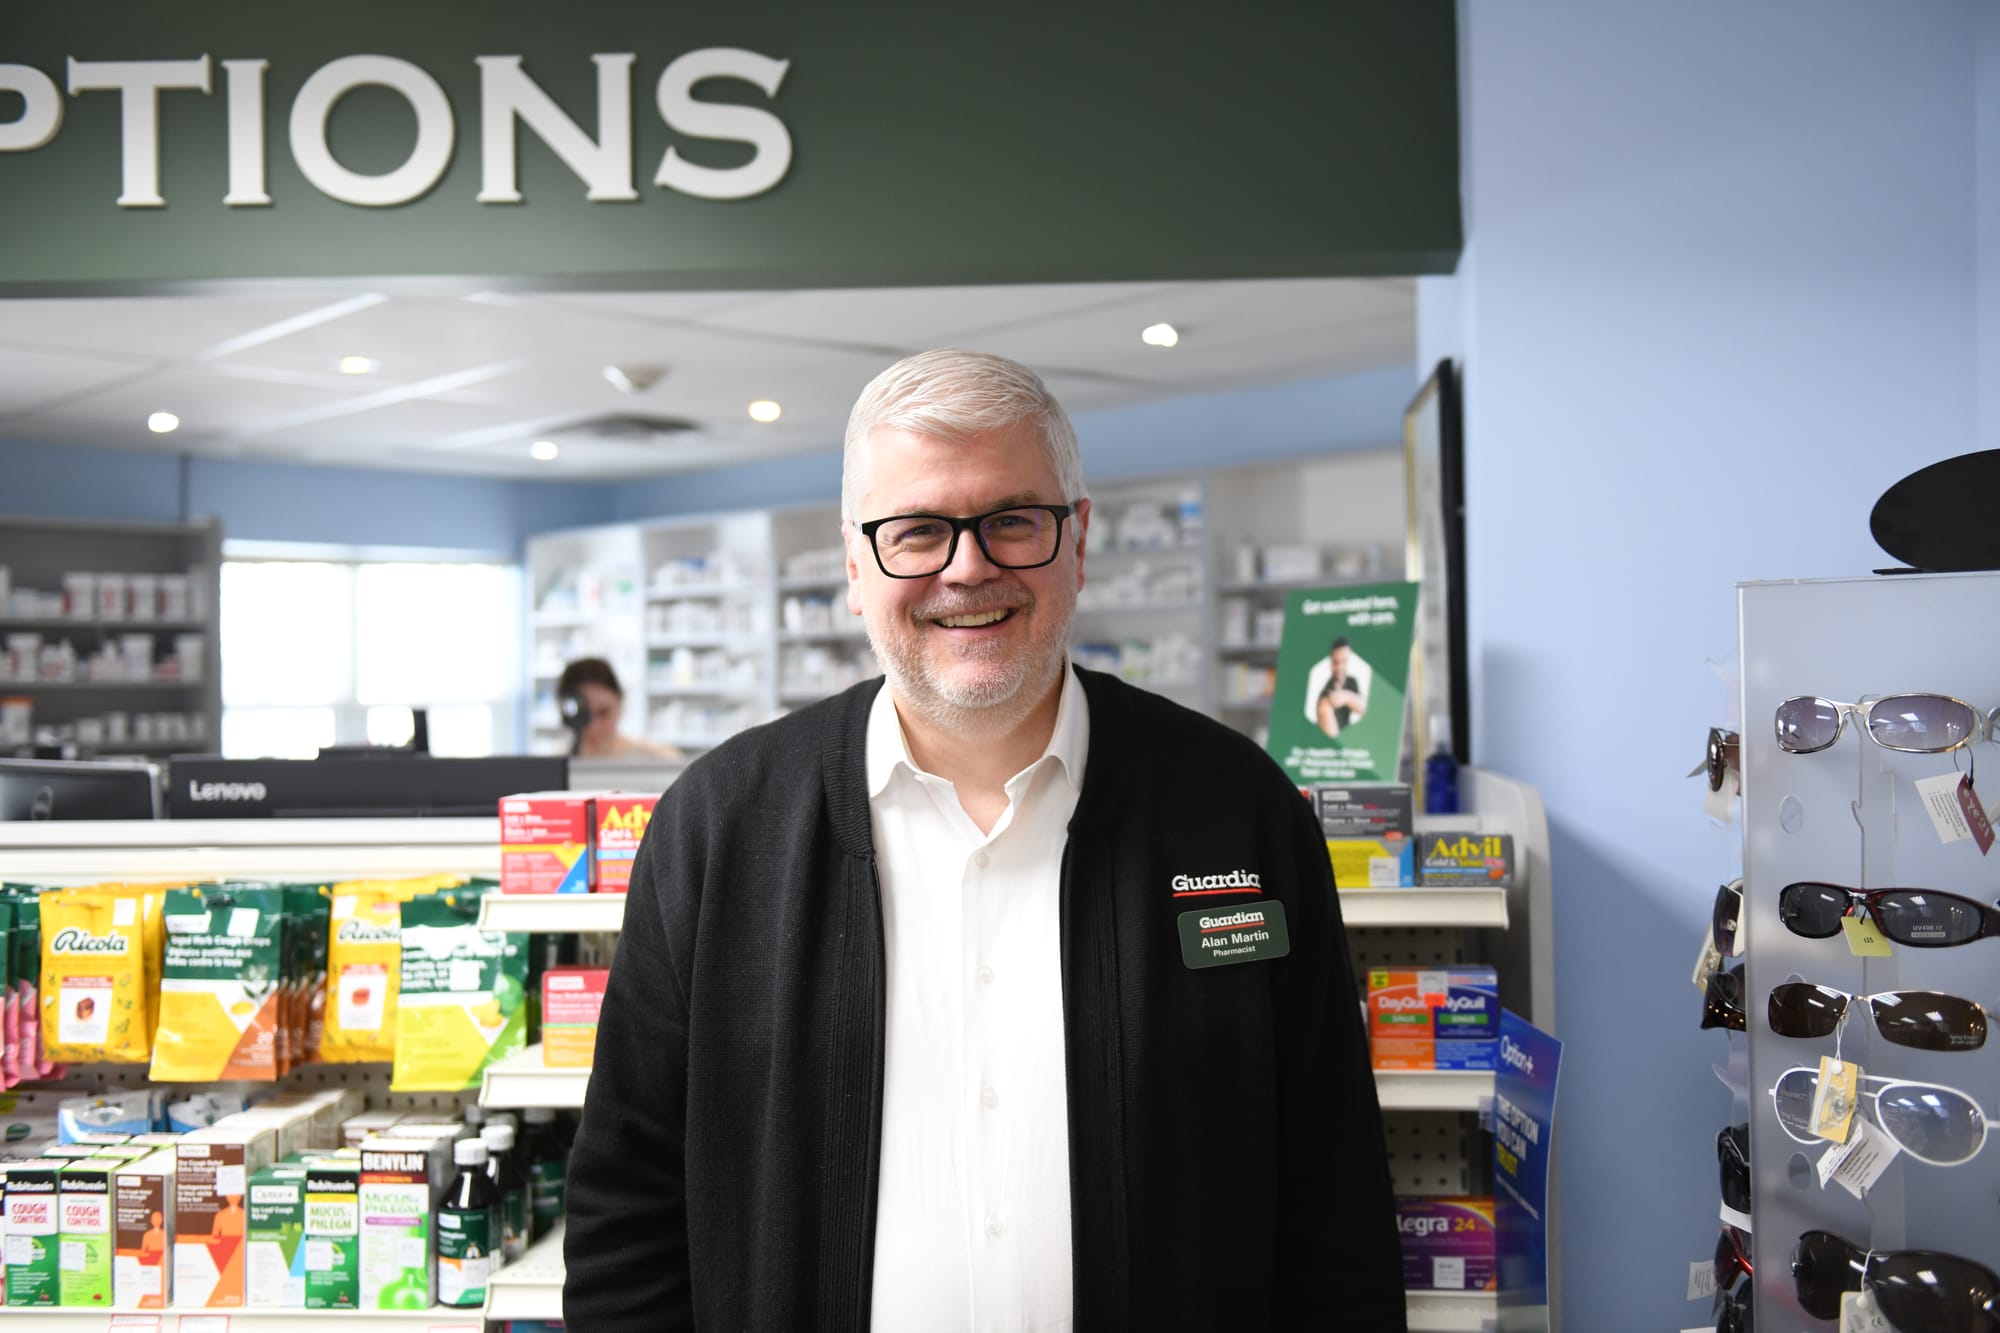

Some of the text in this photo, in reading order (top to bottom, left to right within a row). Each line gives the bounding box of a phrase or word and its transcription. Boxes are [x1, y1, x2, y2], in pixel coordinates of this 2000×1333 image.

[189, 779, 267, 801] Lenovo
[1429, 837, 1502, 859] Advil
[1199, 912, 1264, 929] Guardian
[54, 930, 125, 951] Ricola
[1201, 930, 1270, 949] Alan Martin
[1213, 945, 1256, 957] Pharmacist
[1511, 1104, 1539, 1145] OPTION
[1511, 1130, 1527, 1161] CAN
[362, 1152, 425, 1172] BENYLIN
[12, 1203, 48, 1214] COUGH
[66, 1205, 100, 1217] COUGH
[310, 1207, 346, 1217] MUCUS
[12, 1215, 49, 1225] CONTROL
[67, 1217, 101, 1227] CONTROL
[310, 1218, 352, 1230] PHLEGM
[1455, 1217, 1475, 1232] 24
